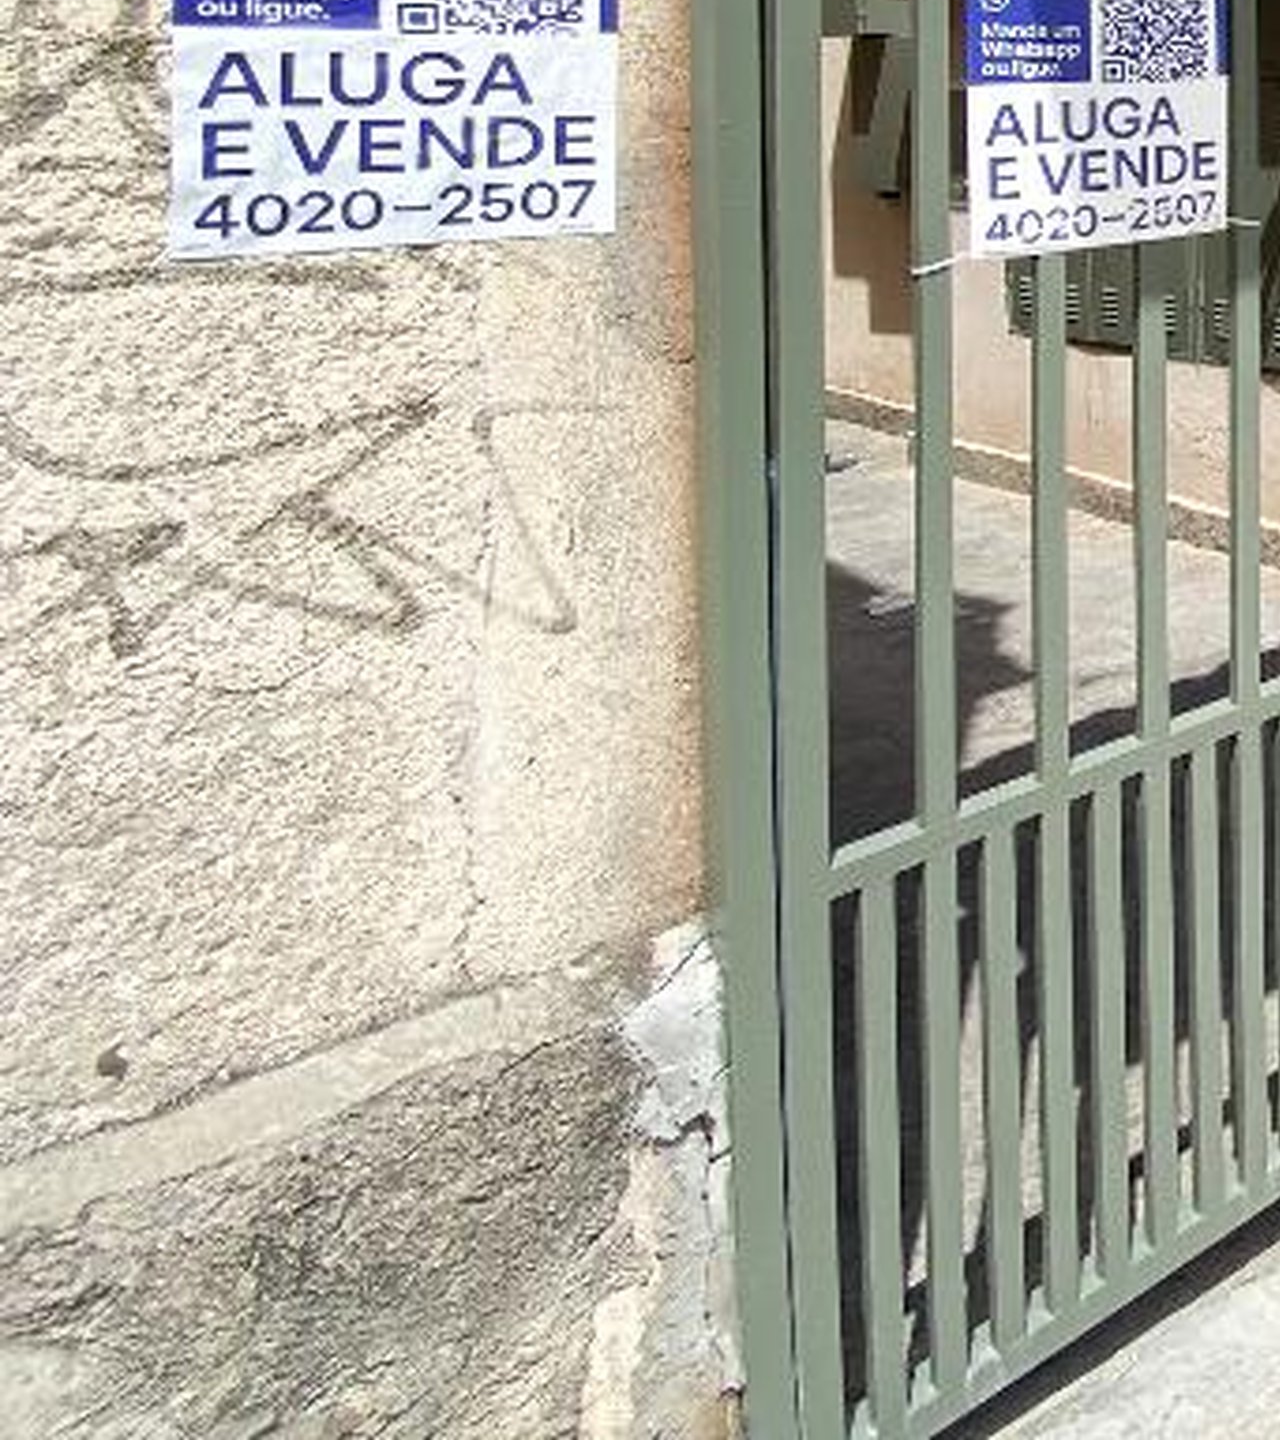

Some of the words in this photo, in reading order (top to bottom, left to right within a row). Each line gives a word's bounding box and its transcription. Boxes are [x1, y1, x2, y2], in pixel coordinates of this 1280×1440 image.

[196, 0, 242, 18] ou
[197, 50, 534, 109] ALUGA
[201, 120, 255, 180] E
[283, 114, 597, 176] VENDE
[984, 95, 1182, 148] ALUGA
[988, 156, 1022, 201] E
[1037, 140, 1219, 197] VENDE
[194, 179, 598, 240] 4020-2507
[984, 190, 1218, 246] 4020-2507
